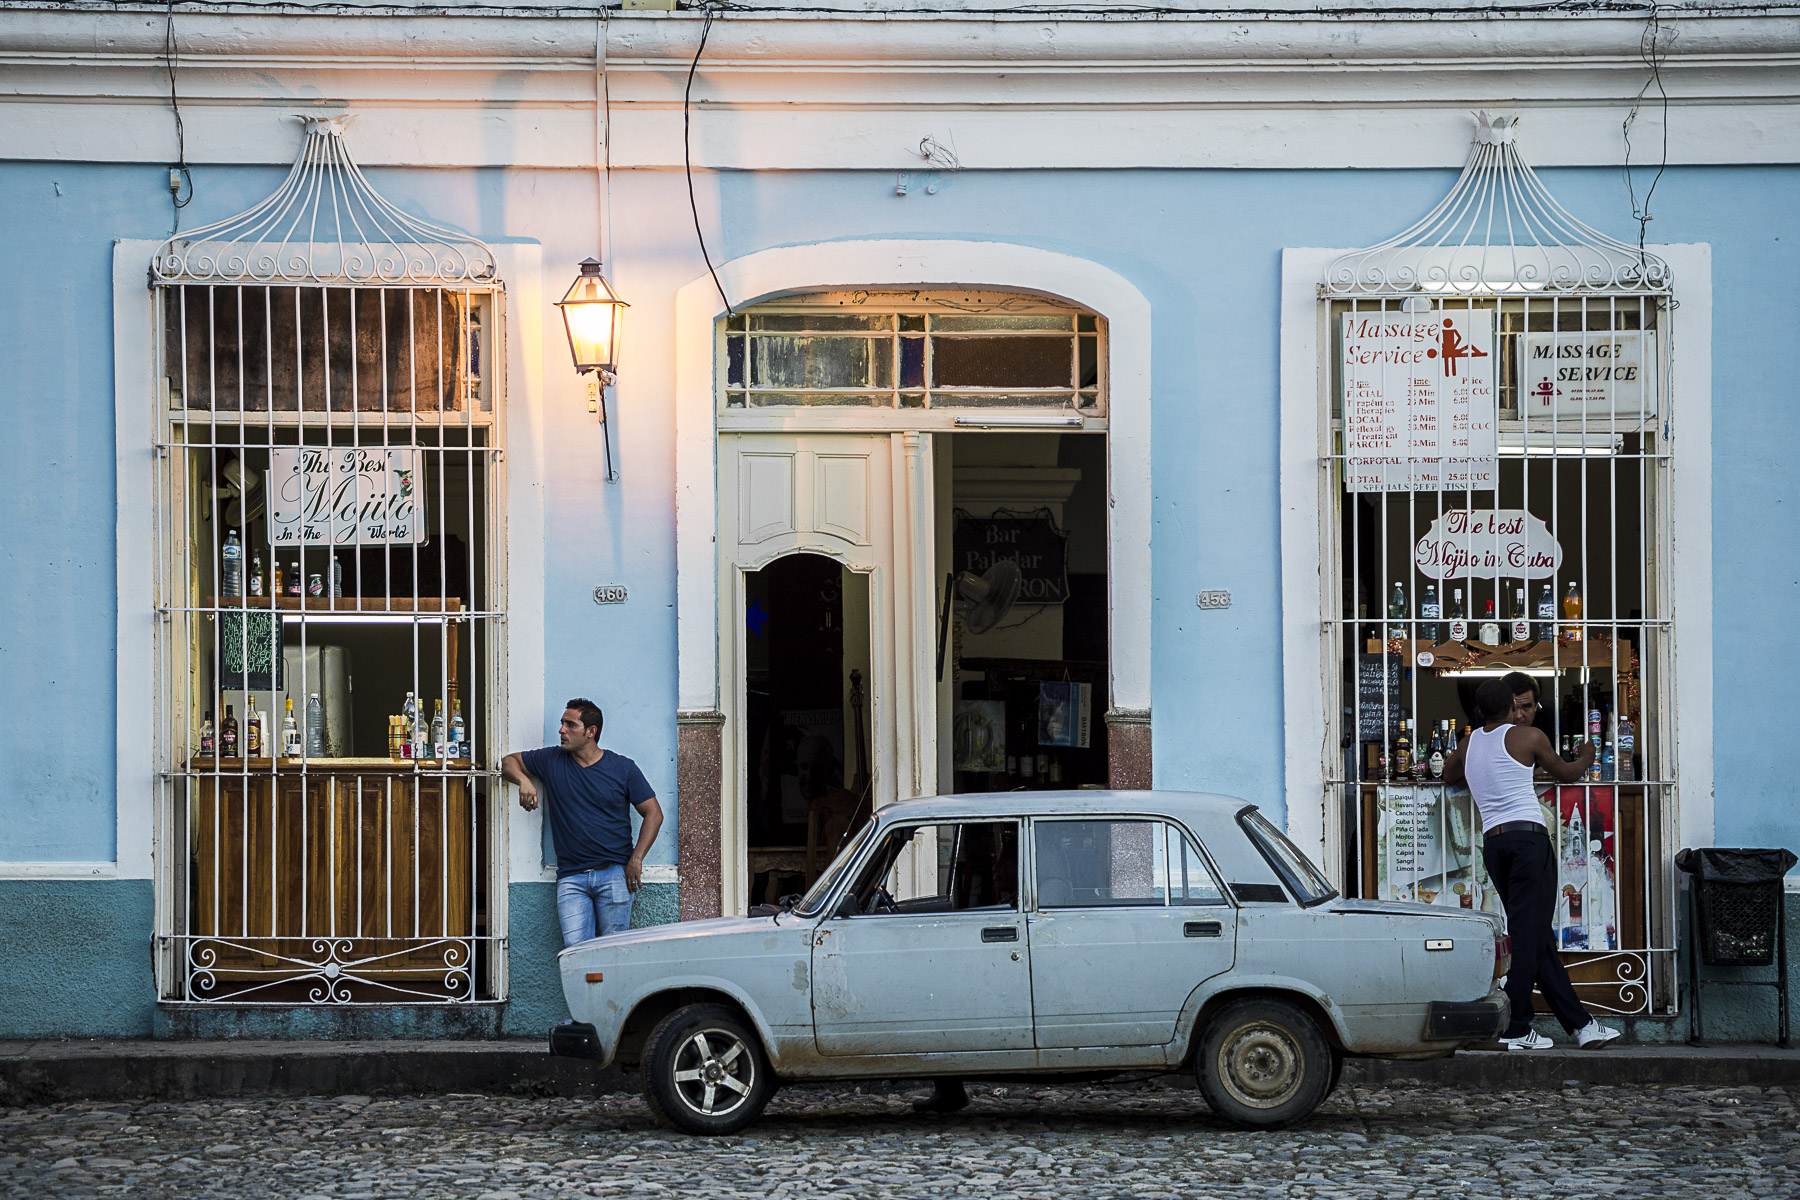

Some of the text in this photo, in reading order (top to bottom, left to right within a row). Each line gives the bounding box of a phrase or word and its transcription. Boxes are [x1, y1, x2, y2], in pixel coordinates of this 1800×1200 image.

[1345, 319, 1438, 342] Massage
[1346, 345, 1424, 364] Service
[1533, 344, 1621, 359] MASSAGE
[1462, 376, 1483, 384] Pice
[1557, 367, 1637, 381] SERVICE
[1347, 390, 1382, 398] FCIAL
[1472, 387, 1492, 395] CUC
[1471, 422, 1491, 430] CUC
[293, 450, 333, 473] The
[274, 473, 418, 544] Mojito
[1448, 511, 1524, 535] The best
[276, 525, 410, 540] In The World
[986, 524, 1021, 544] Bar
[1416, 539, 1555, 578] Mojito in Cuba
[597, 587, 625, 602] 460
[1201, 592, 1229, 607] 458
